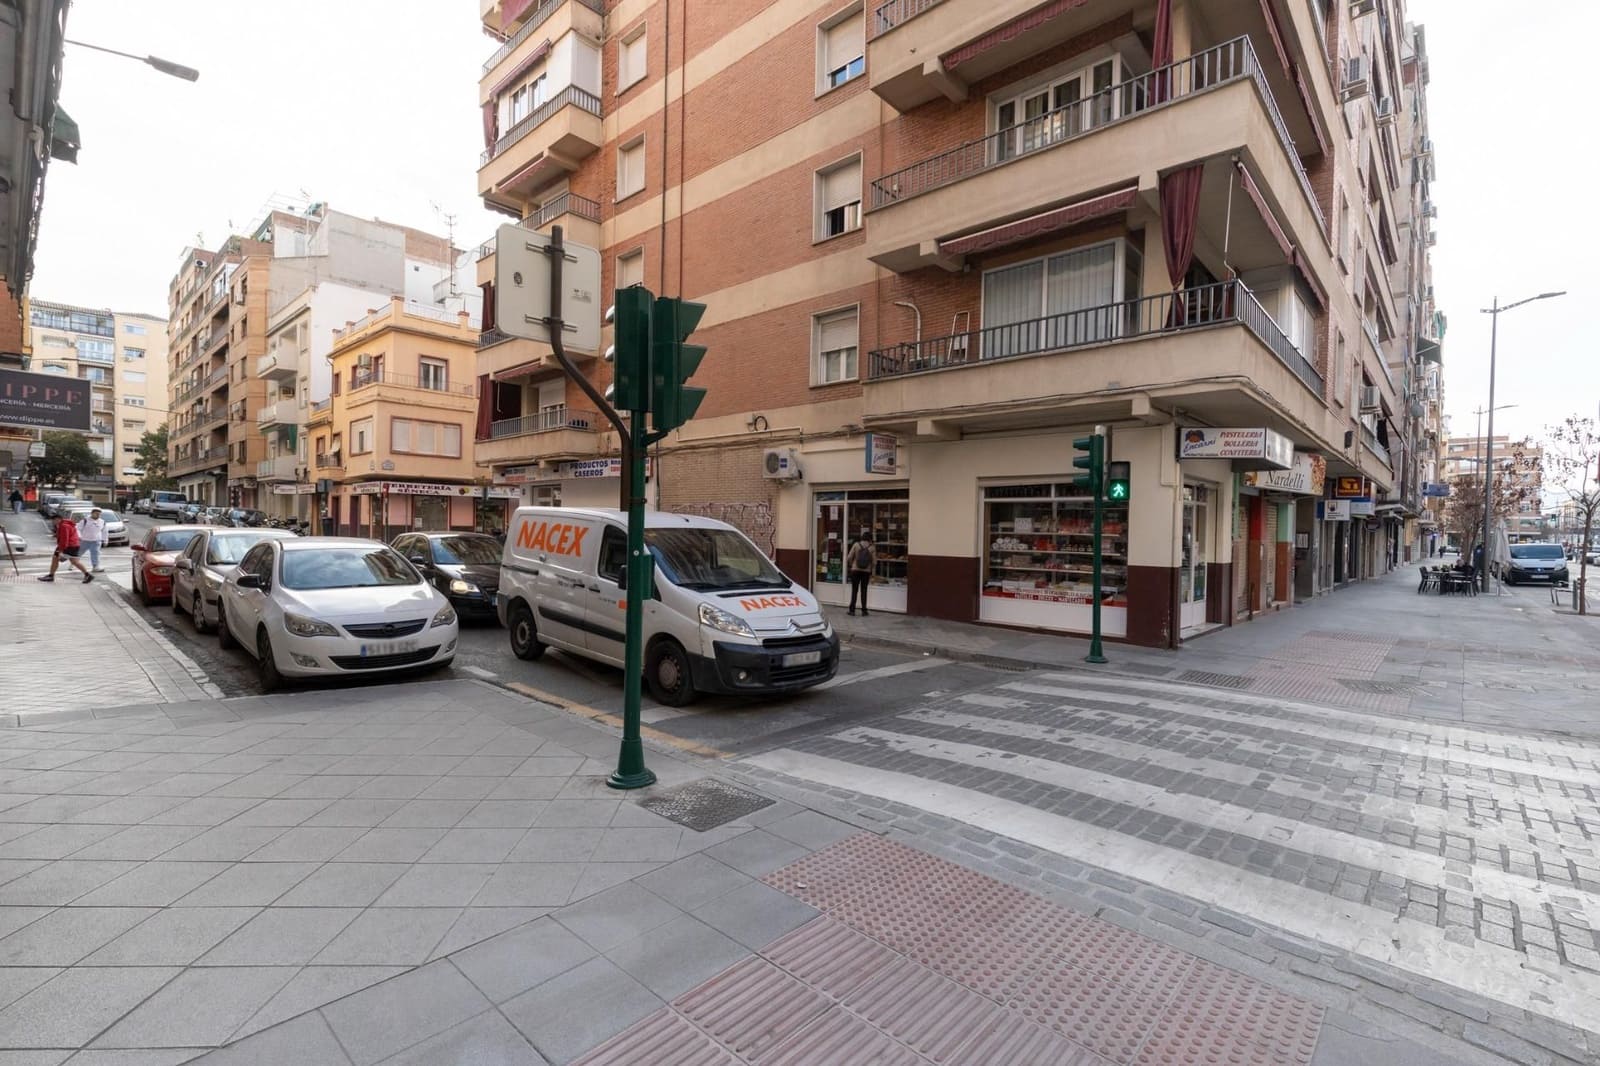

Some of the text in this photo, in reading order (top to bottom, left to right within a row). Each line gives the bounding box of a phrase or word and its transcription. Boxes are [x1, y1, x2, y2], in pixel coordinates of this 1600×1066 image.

[569, 460, 609, 470] PRODUCTOS
[574, 469, 604, 478] CASEROS
[1265, 471, 1305, 489] Nardelli
[391, 483, 452, 491] ERRETERÍA
[516, 520, 589, 557] NACEX
[740, 596, 807, 611] NACEX
